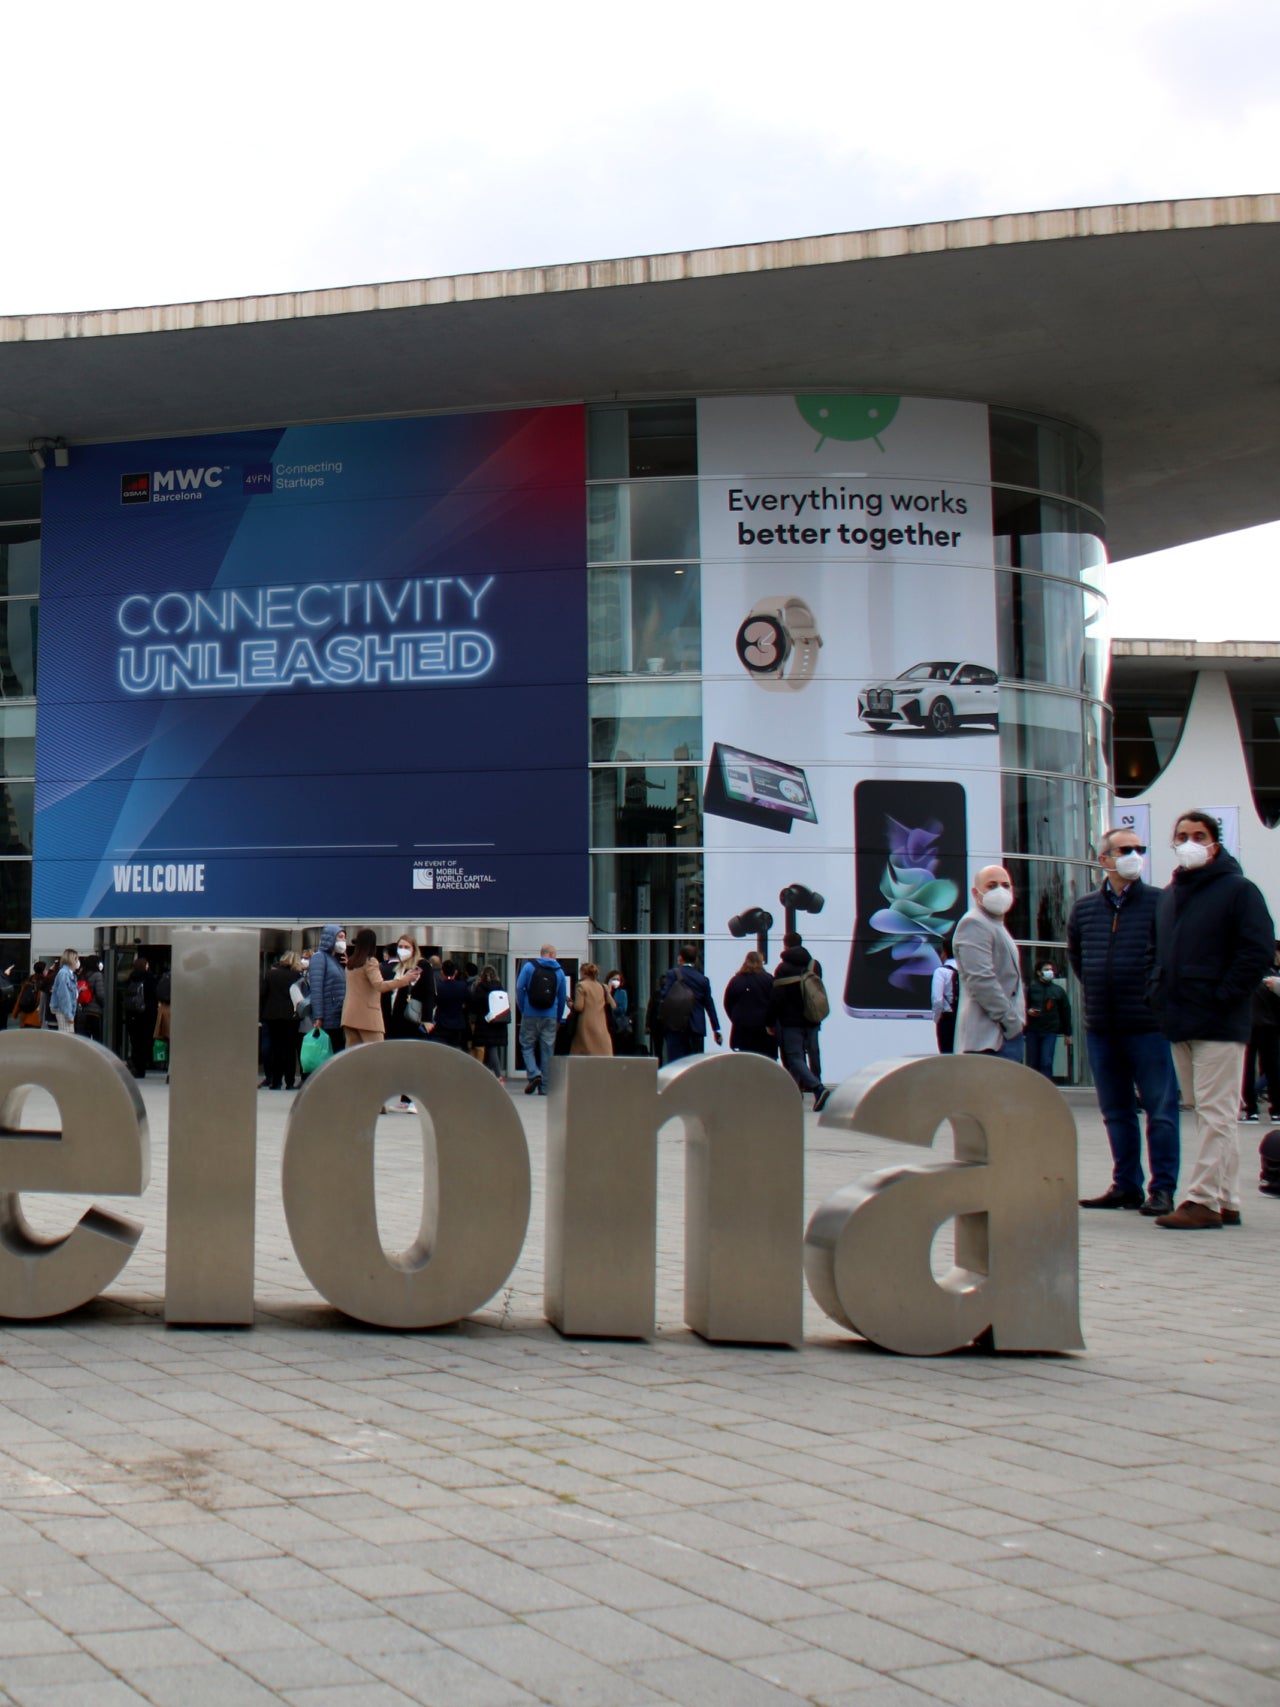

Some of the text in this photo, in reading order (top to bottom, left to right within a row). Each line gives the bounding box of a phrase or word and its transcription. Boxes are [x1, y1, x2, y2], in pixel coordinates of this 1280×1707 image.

[245, 473, 271, 485] 4YFN
[276, 461, 343, 476] Connecting
[276, 476, 325, 489] Startups
[153, 491, 203, 503] Barcelona
[728, 487, 968, 516] Everything works
[738, 521, 961, 550] better together
[117, 575, 496, 636] CONNECTIVITY
[117, 630, 496, 694] UNLEASHED
[113, 864, 205, 892] WELCOME
